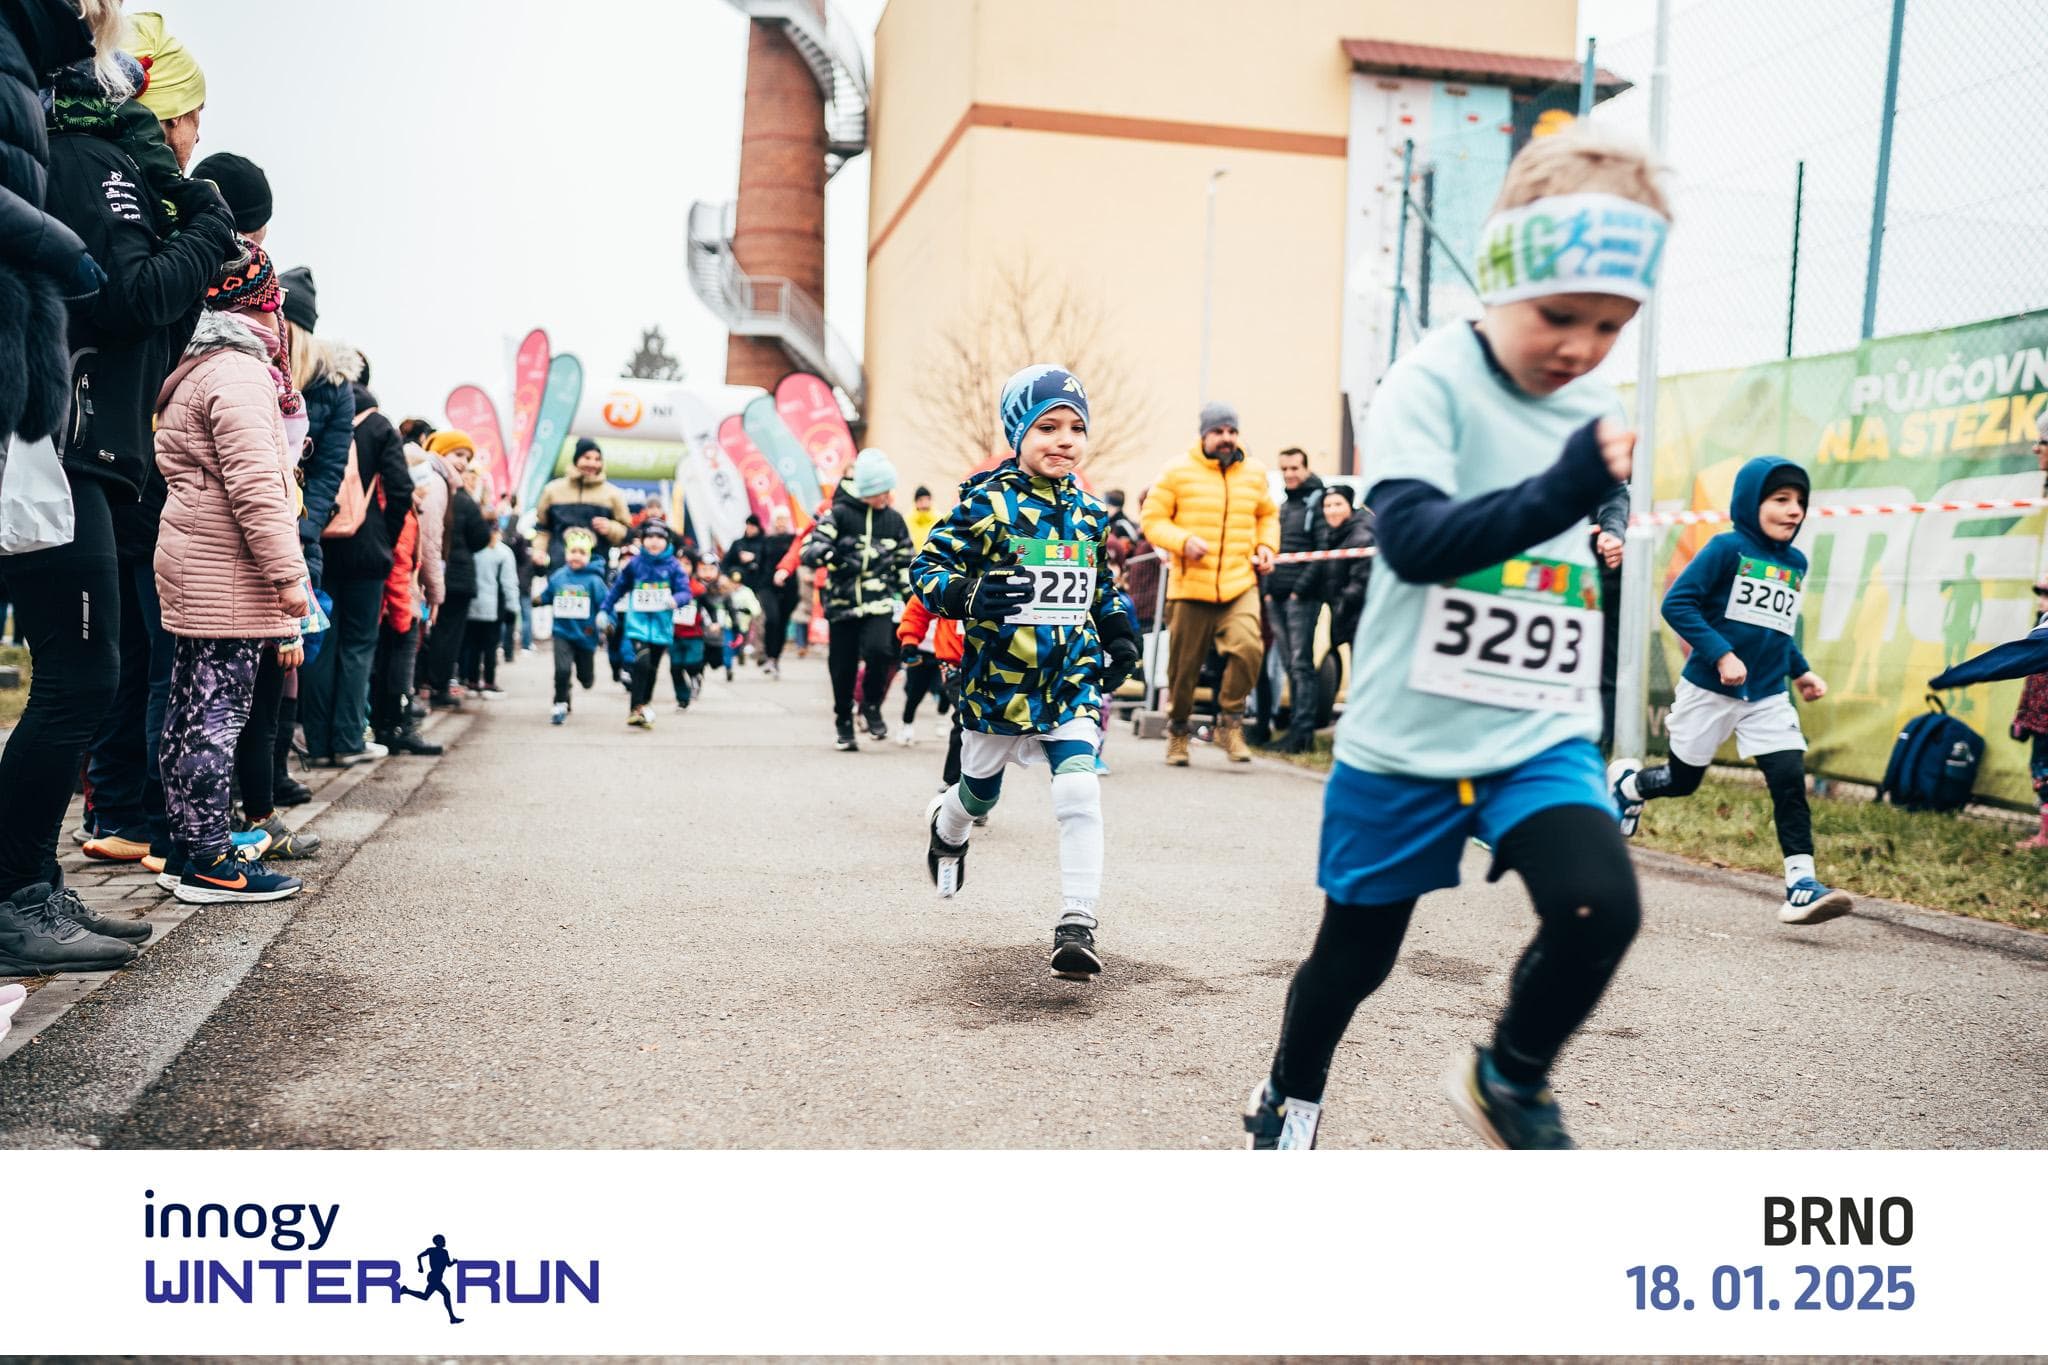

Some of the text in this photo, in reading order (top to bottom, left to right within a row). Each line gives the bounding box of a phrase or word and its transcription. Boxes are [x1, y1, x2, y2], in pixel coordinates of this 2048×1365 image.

[1816, 416, 1890, 464] NA
[1736, 581, 1794, 616] 3202
[1434, 599, 1583, 674] 3293
